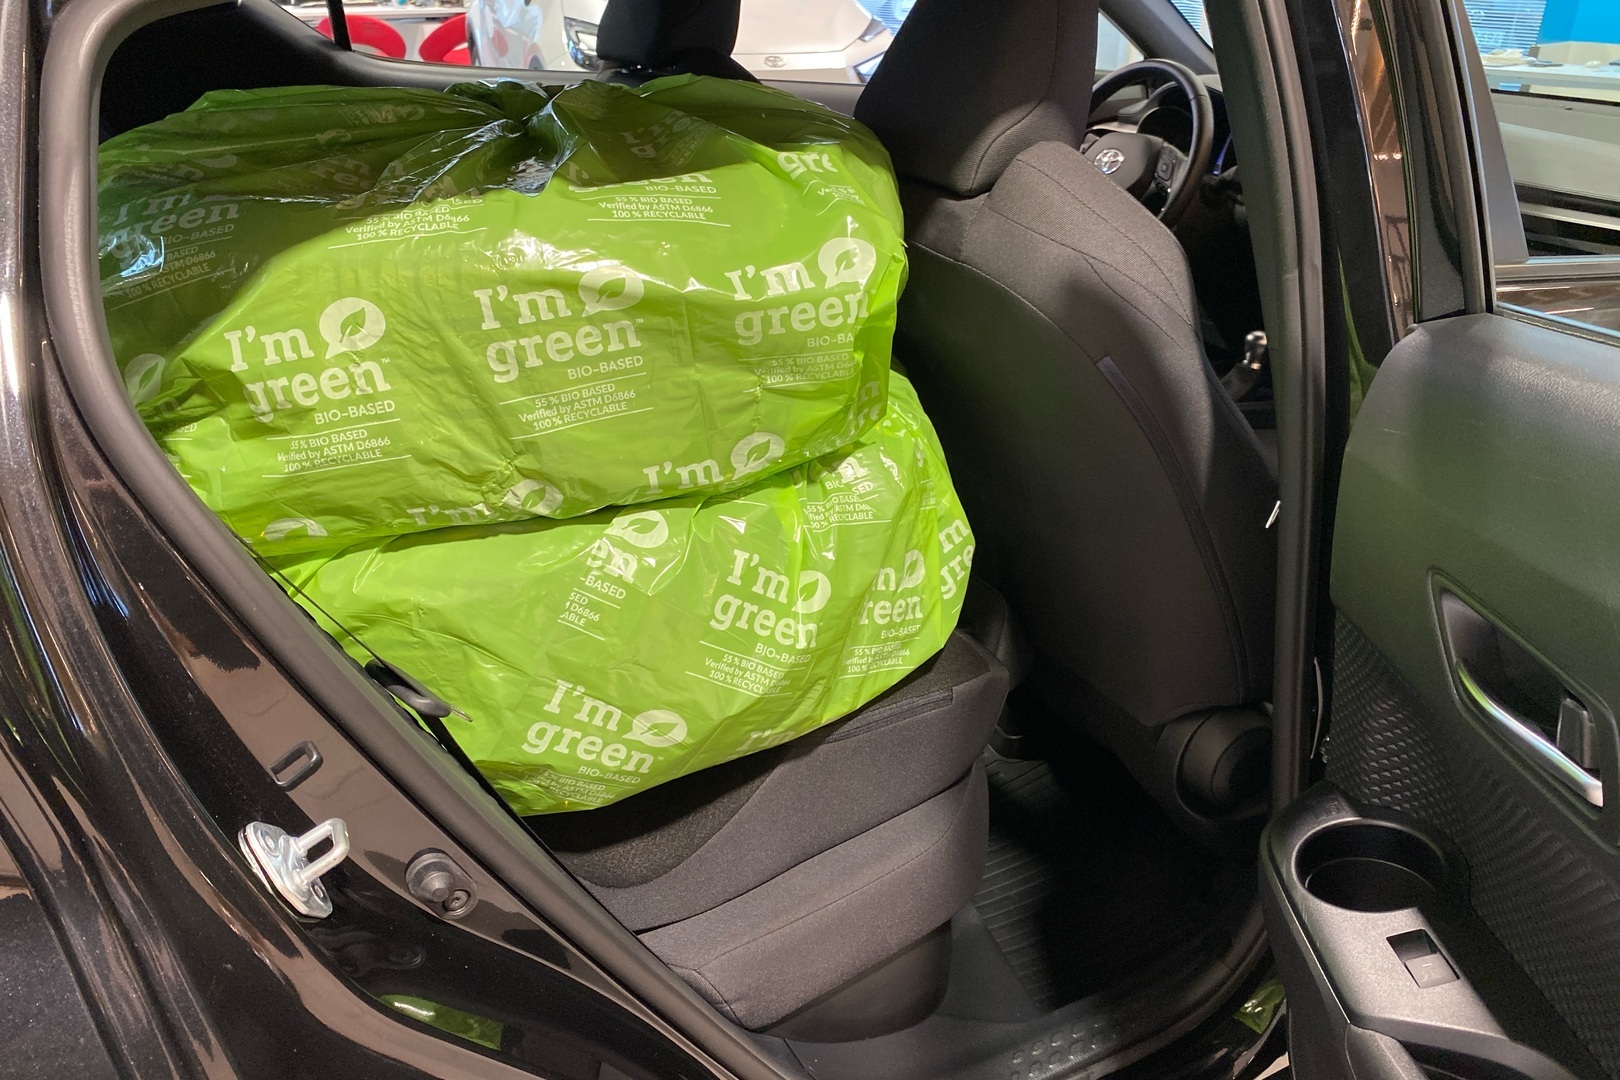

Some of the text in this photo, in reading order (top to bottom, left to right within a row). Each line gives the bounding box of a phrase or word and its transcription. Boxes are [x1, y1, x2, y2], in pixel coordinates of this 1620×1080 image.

[645, 185, 717, 194] BIO-BASED
[599, 202, 637, 210] Verified
[639, 203, 650, 211] by
[682, 205, 714, 213] D6866
[660, 197, 693, 205] BASED
[345, 221, 386, 233] Verified
[388, 220, 401, 230] by
[403, 216, 433, 227] ASTM
[612, 210, 630, 218] 100
[644, 211, 707, 220] RECYCLABLE
[357, 231, 376, 240] 100
[390, 222, 459, 236] RECYCLABLE
[151, 262, 211, 290] RECYCLABLE
[724, 261, 816, 301] I'm
[473, 285, 572, 330] I'm
[735, 290, 870, 346] green
[224, 326, 315, 372] I'm
[486, 320, 642, 383] green
[797, 356, 815, 365] BIO
[817, 353, 849, 363] BASED
[568, 355, 644, 380] BIO-BASED
[793, 365, 804, 373] by
[806, 363, 835, 372] ASTM
[766, 374, 783, 384] 100
[785, 374, 794, 382] %
[518, 389, 636, 422] Verified by ASTM D6866
[535, 383, 616, 408] 55 % BIO BASED
[314, 400, 396, 425] BIO-BASED
[533, 402, 628, 431] 100 % RECYCLABLE
[277, 436, 391, 461] Verified by ASTM D6866
[290, 429, 368, 449] 55 % BIO BASED
[284, 449, 383, 472] 100 % RECYCLABLE
[642, 458, 725, 495] I'm
[806, 505, 816, 513] 55
[817, 505, 825, 513] %
[835, 504, 854, 513] ASTM
[726, 549, 790, 604] I'm
[570, 603, 600, 622] D6866
[709, 594, 818, 650] green
[755, 642, 812, 664] BIO-BASED
[854, 648, 863, 656] 55
[705, 657, 734, 673] Verified
[734, 667, 743, 677] by
[743, 671, 769, 686] ASTM
[709, 670, 725, 680] 100
[725, 674, 732, 683] %
[722, 654, 785, 679] 55 % BIO BASED
[847, 665, 861, 673] 100
[543, 679, 622, 731] I'm
[521, 721, 654, 774] green
[559, 776, 576, 785] BIO
[576, 778, 606, 791] BASED
[578, 765, 641, 784] BIO-BASED
[561, 785, 589, 795] ASTM
